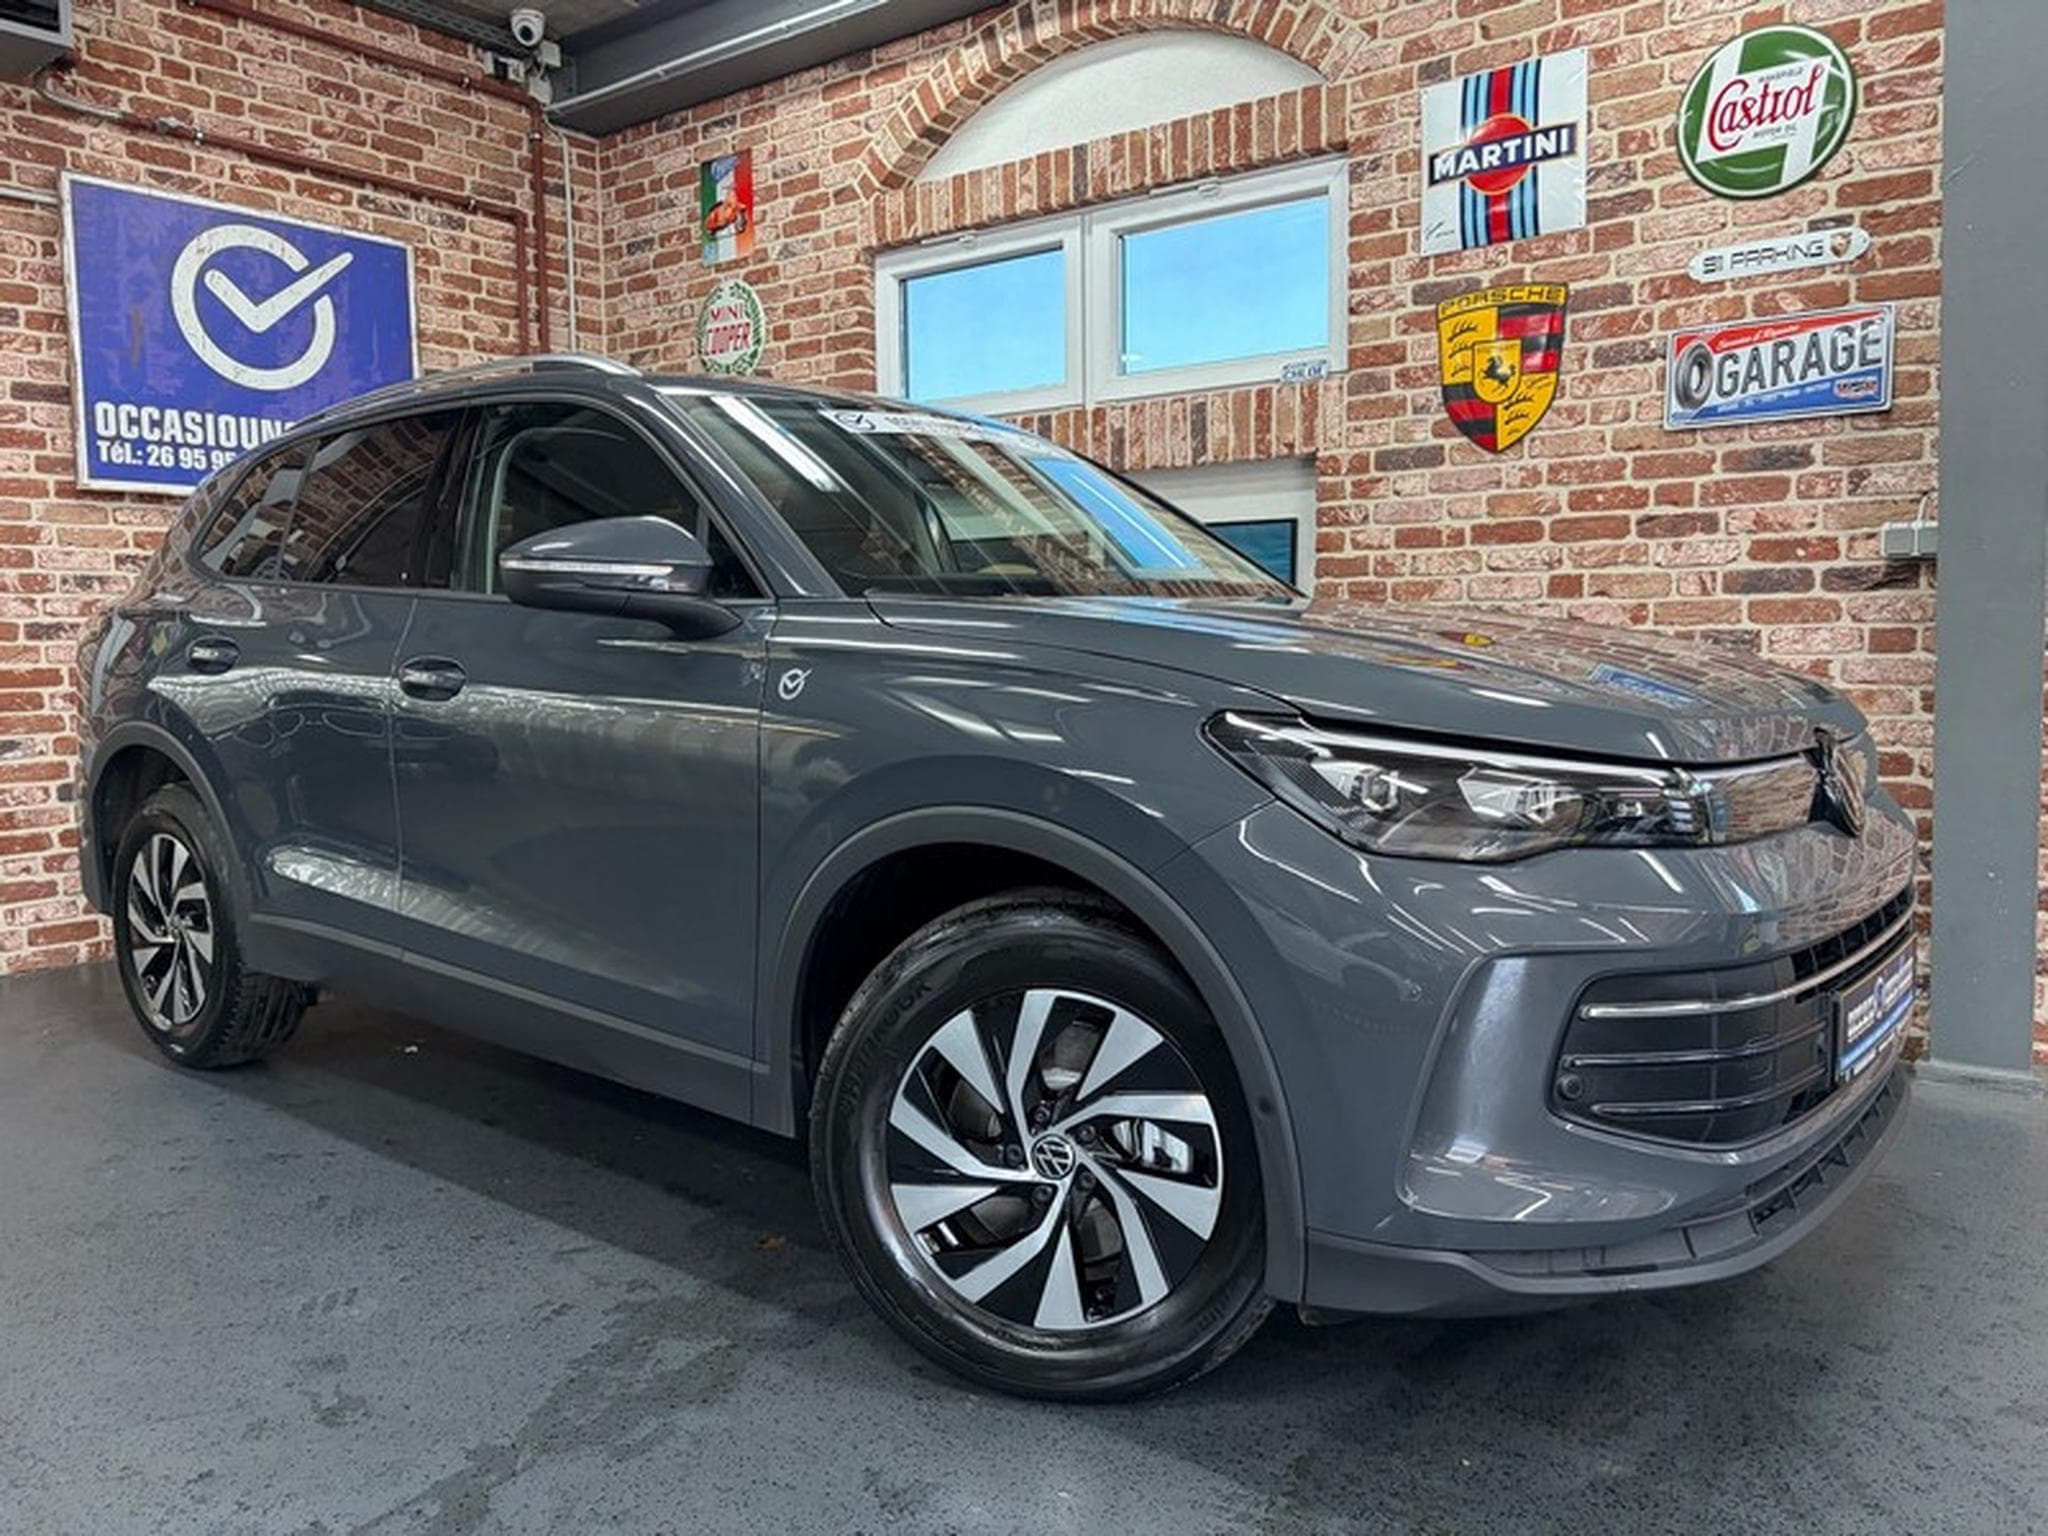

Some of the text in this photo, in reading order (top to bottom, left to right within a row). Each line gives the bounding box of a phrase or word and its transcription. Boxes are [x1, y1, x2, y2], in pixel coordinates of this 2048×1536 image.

[1708, 63, 1826, 152] Castrol
[1433, 127, 1569, 180] MARTINI
[1730, 239, 1825, 270] PARKING
[1441, 285, 1562, 315] PORSCHE
[1715, 317, 1885, 399] GARAGE
[94, 401, 297, 450] OCCASIOUN
[97, 440, 143, 465] Tél.:
[147, 446, 174, 467] 26
[178, 449, 207, 470] 95
